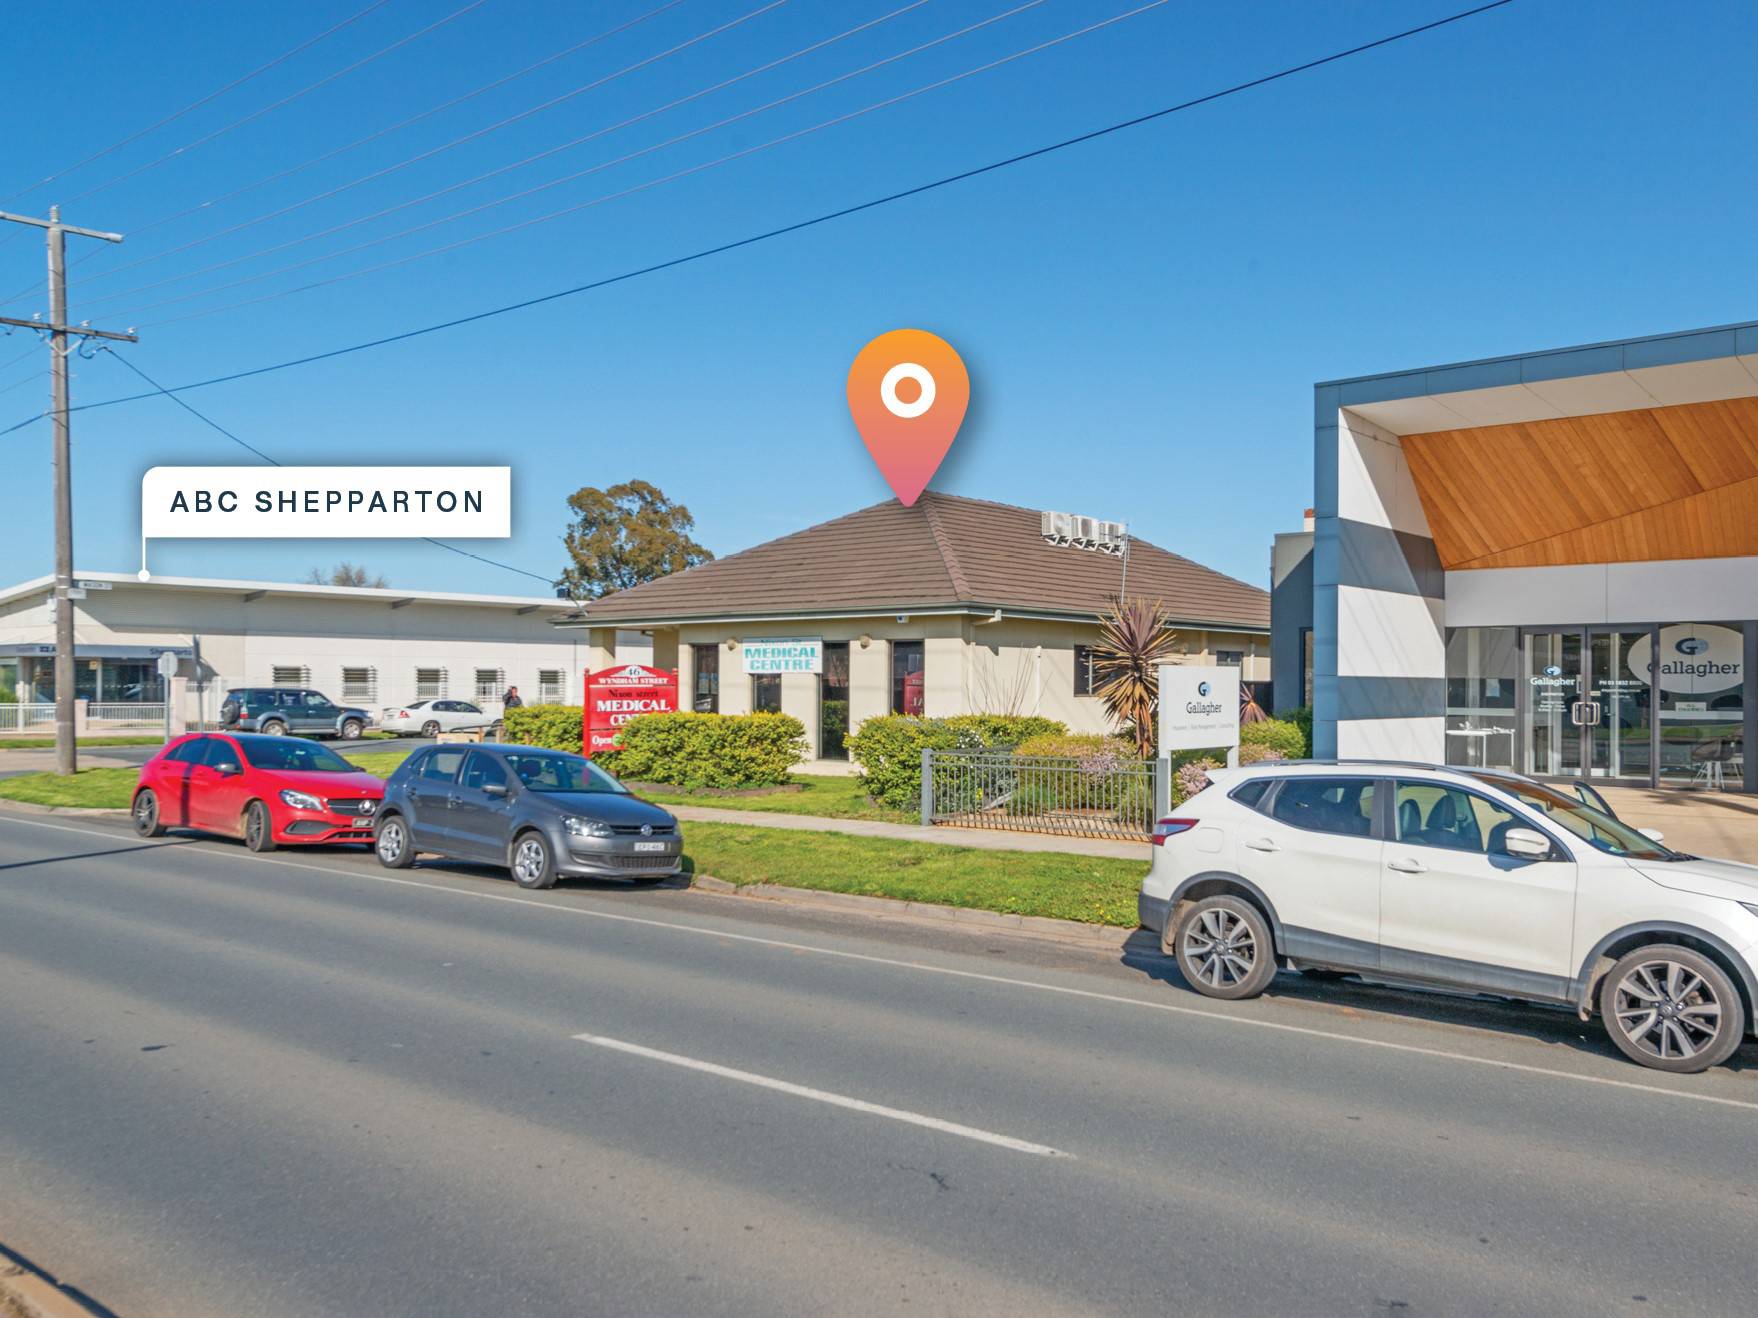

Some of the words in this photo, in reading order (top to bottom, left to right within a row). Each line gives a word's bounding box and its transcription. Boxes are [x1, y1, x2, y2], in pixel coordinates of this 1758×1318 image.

[745, 646, 818, 658] MEDICAL
[750, 659, 814, 671] CENTRE
[629, 668, 640, 676] 46
[598, 677, 638, 685] WYNDHAM
[640, 677, 669, 685] STREET
[1530, 677, 1576, 687] Gallagher
[597, 699, 671, 712] MEDICAL
[1186, 701, 1222, 716] Gallagher
